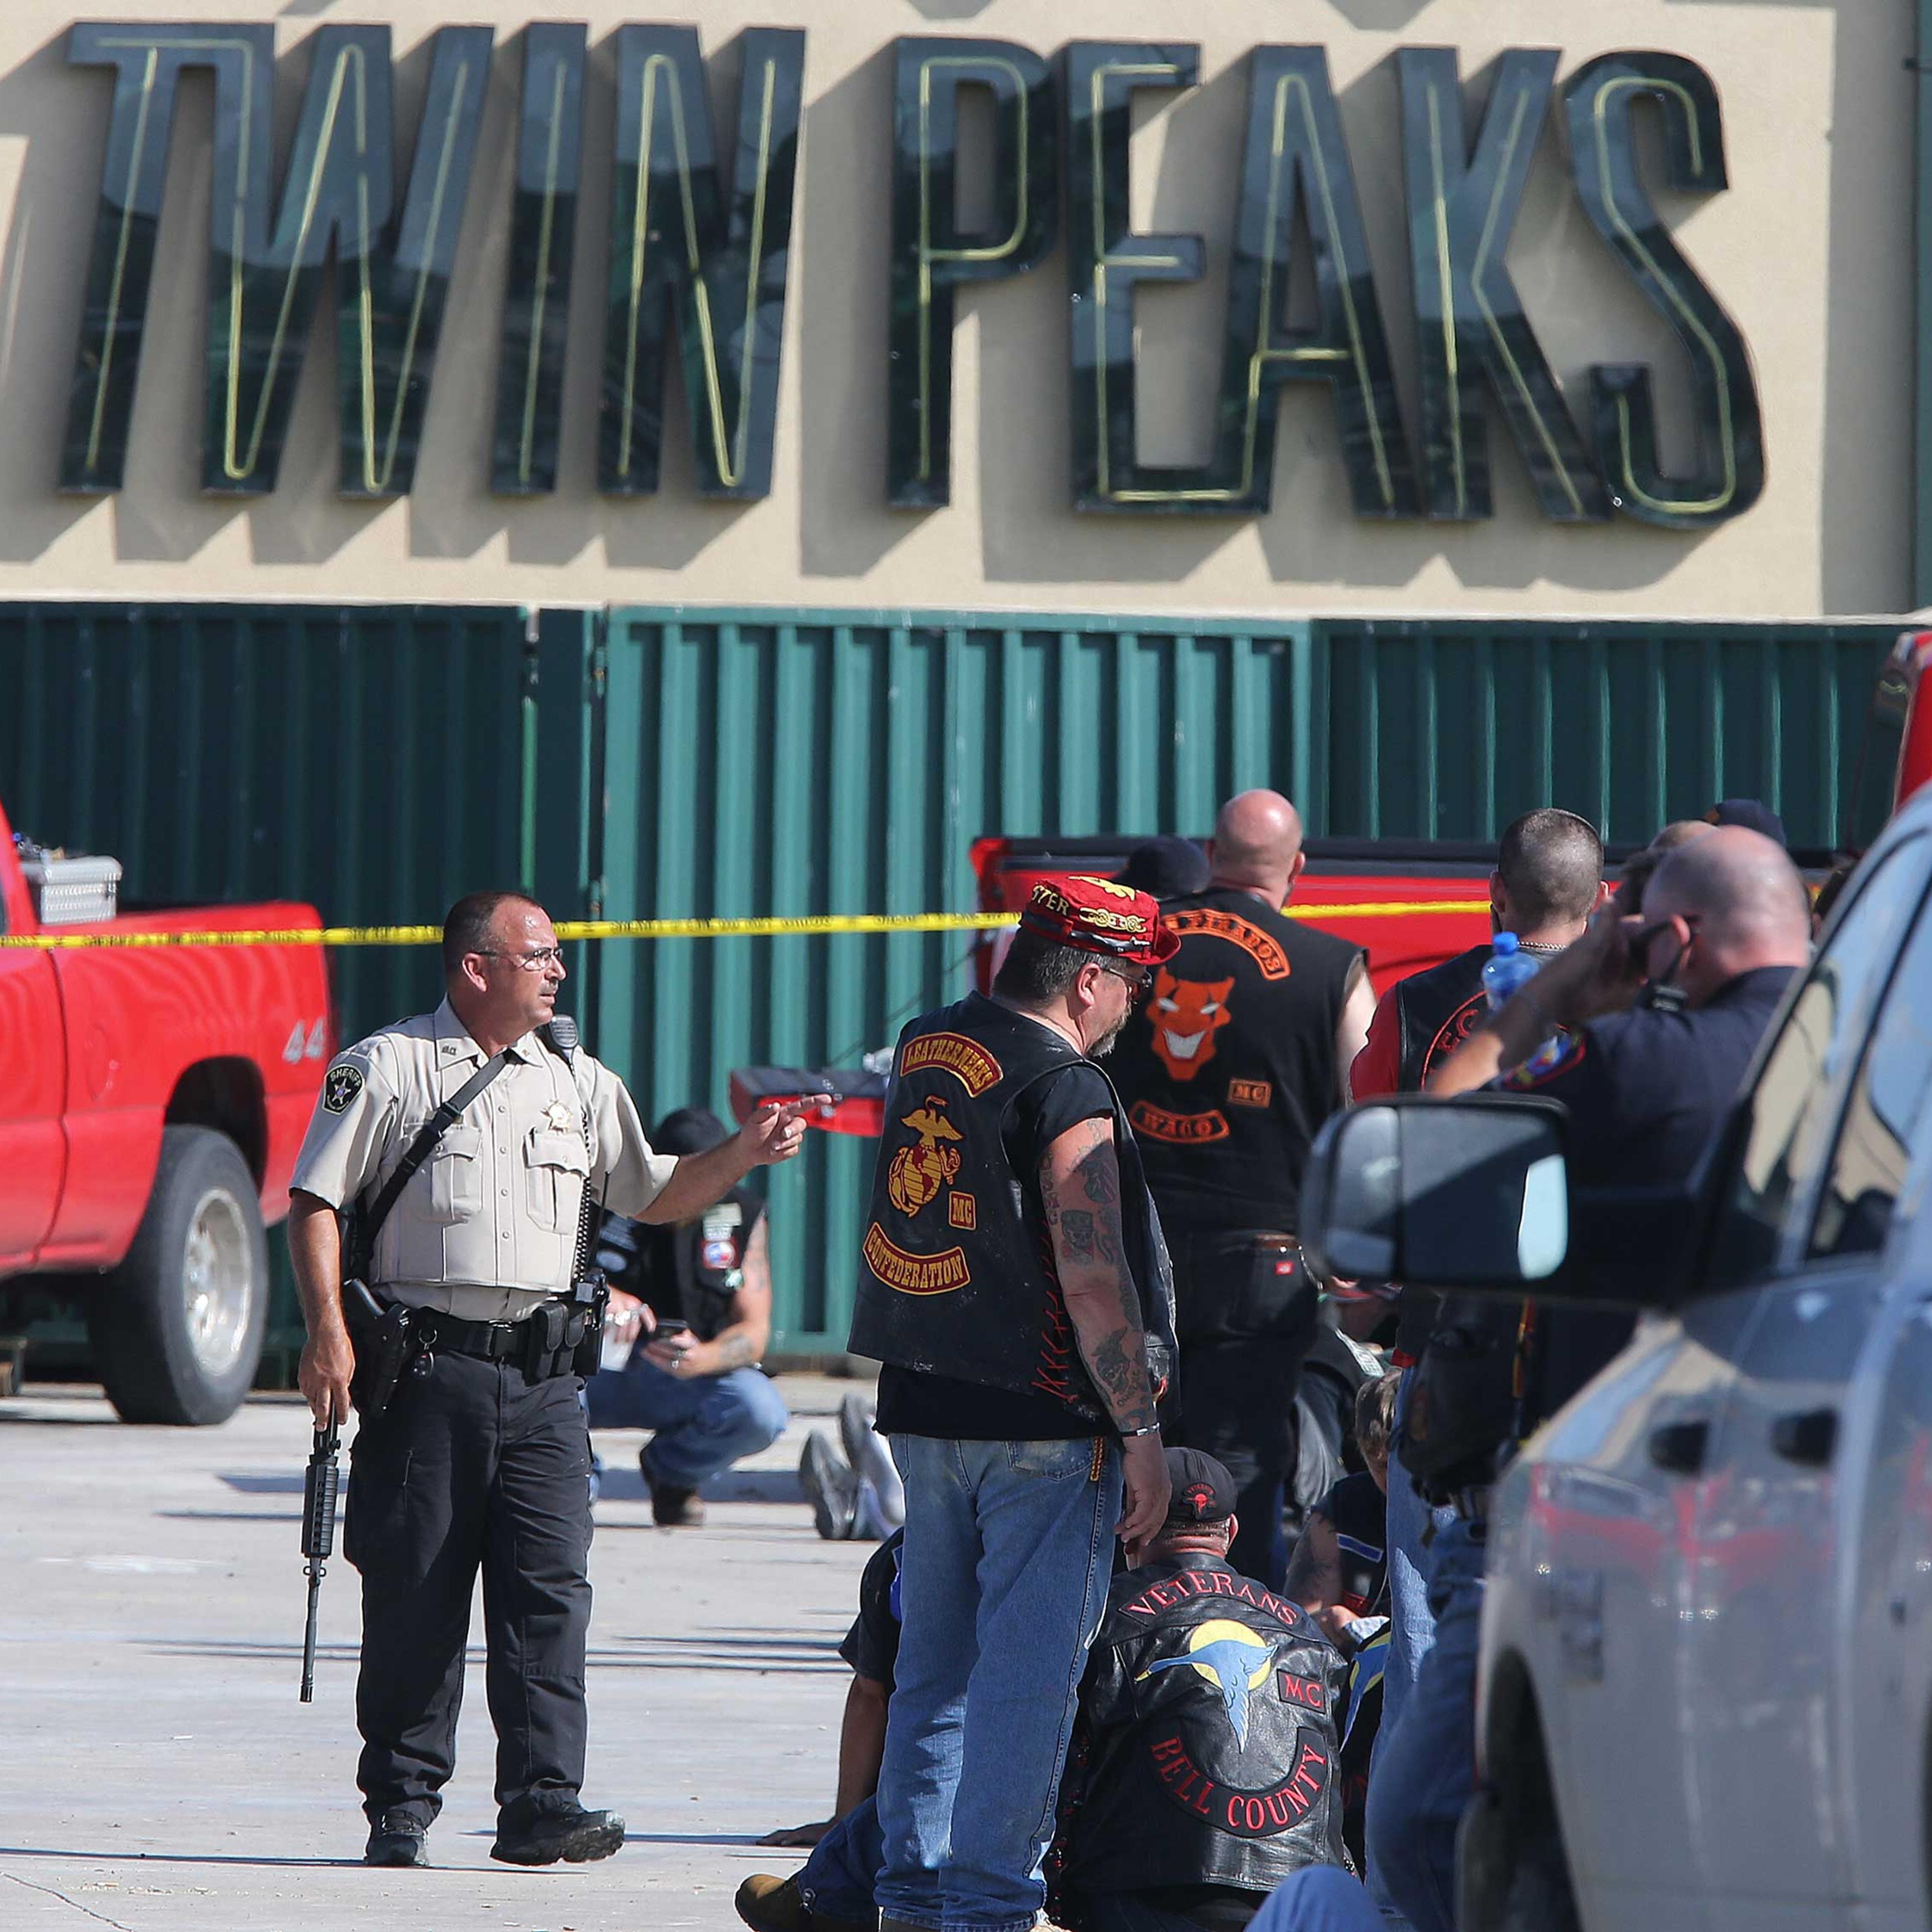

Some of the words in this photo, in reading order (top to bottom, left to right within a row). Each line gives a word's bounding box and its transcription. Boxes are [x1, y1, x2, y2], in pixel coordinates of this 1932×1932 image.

[59, 22, 807, 497] TWIN
[887, 34, 1769, 530] PEAKS
[330, 1068, 361, 1087] SHERIFF
[906, 1039, 994, 1090] LEATHERNECKS
[952, 1197, 973, 1224] MC
[867, 1231, 964, 1289] CONFEDERATION
[1128, 1570, 1298, 1626] VETERANS
[1284, 1674, 1323, 1708] MC
[1150, 1736, 1215, 1815] BELL
[1227, 1744, 1328, 1830] COUNTY
